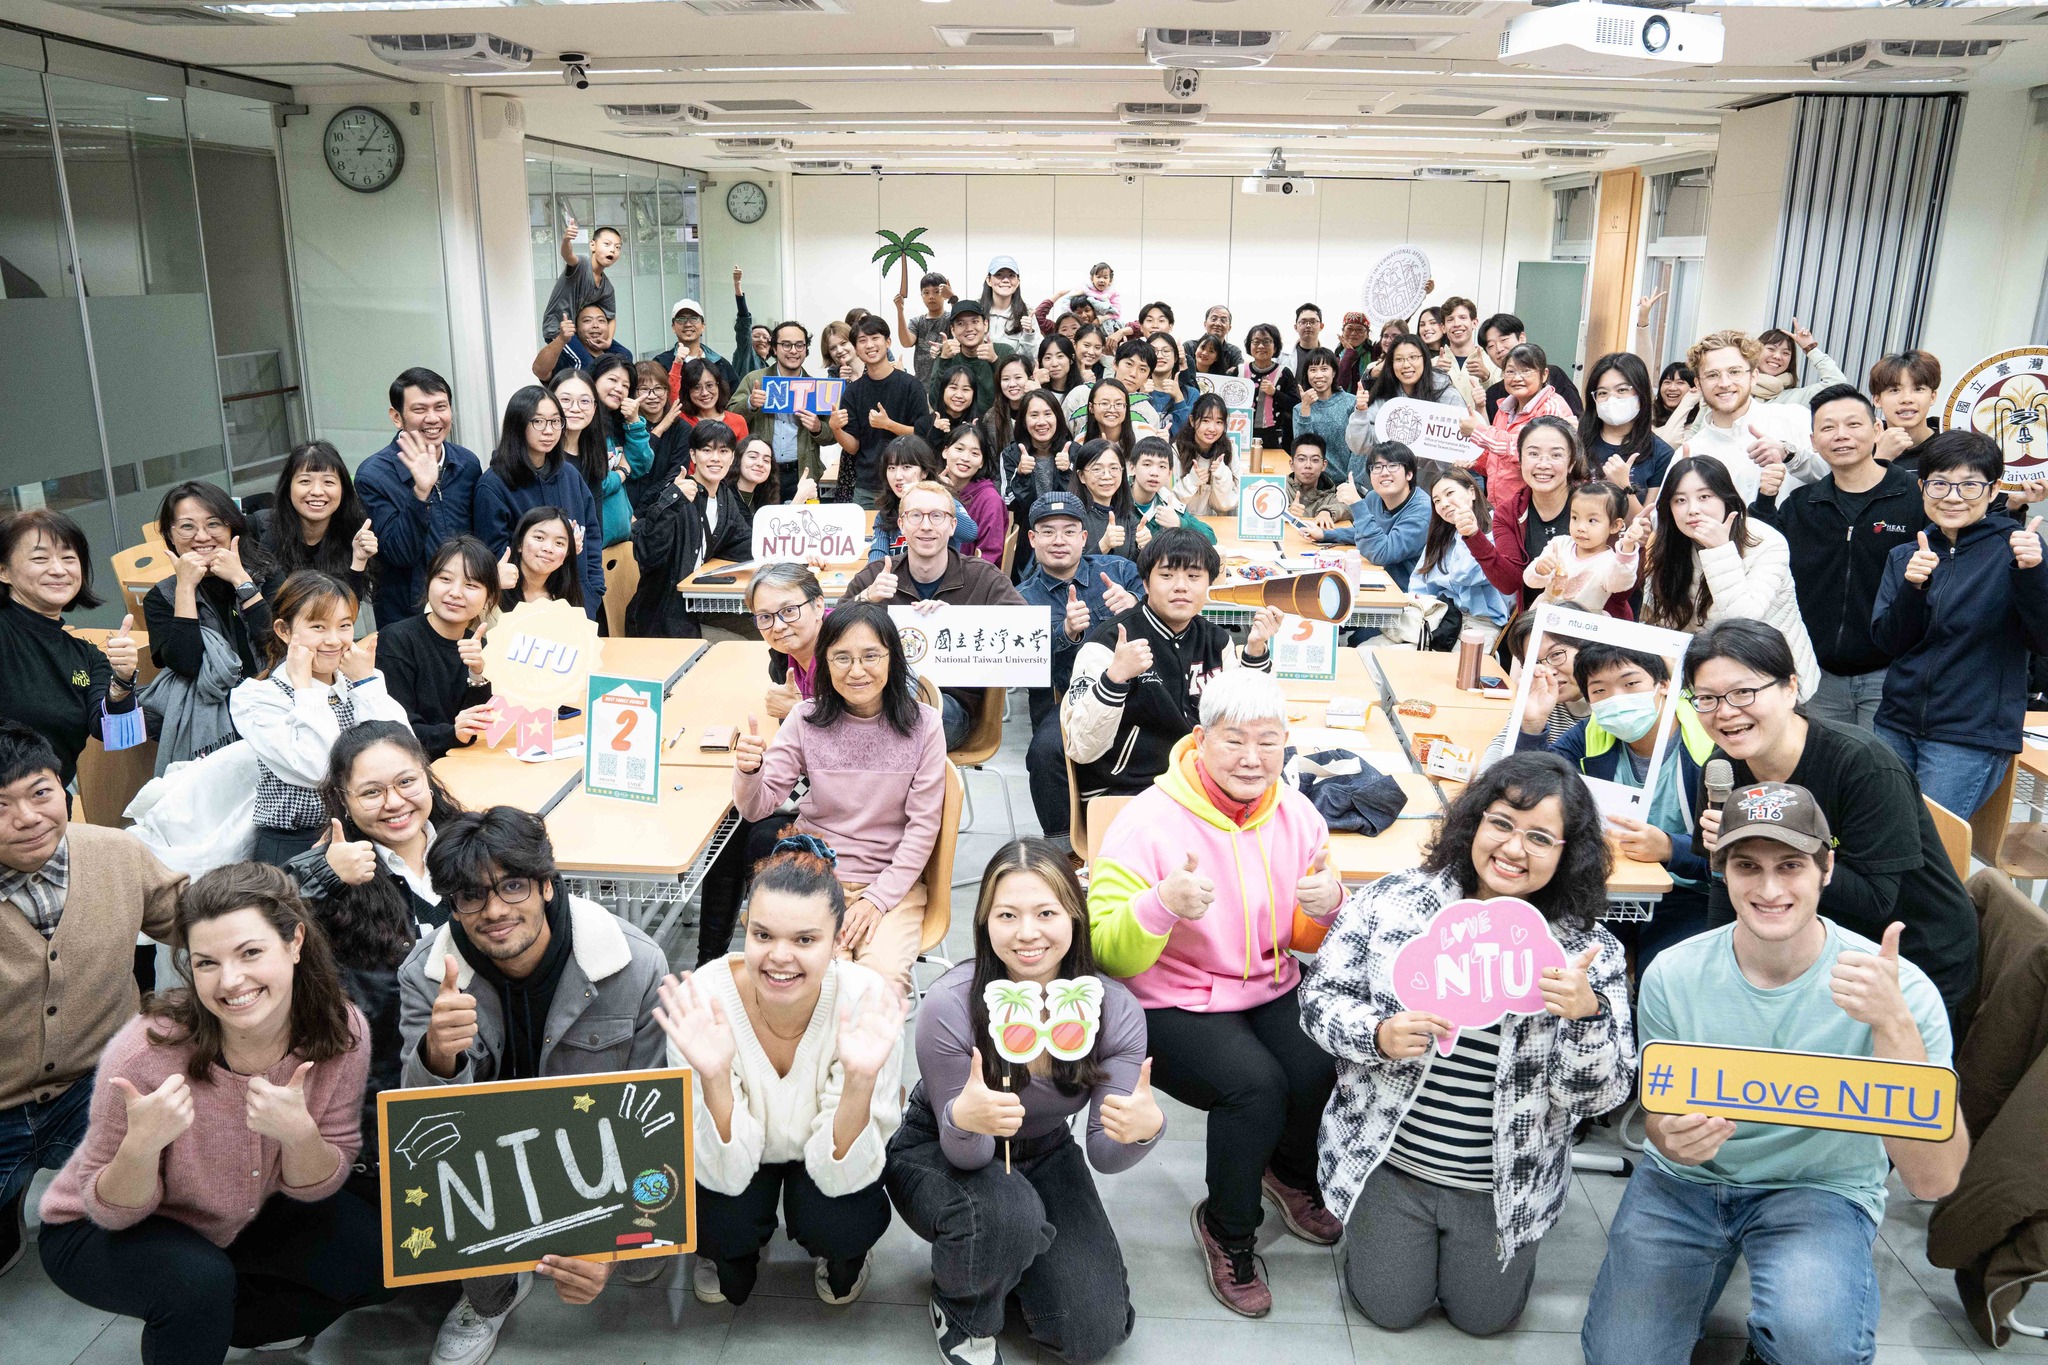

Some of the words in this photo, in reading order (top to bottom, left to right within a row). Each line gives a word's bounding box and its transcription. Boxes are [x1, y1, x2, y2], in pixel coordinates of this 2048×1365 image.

[342, 120, 351, 130] 11
[355, 115, 366, 125] 12
[333, 132, 344, 142] 10
[382, 129, 390, 139] 2
[331, 147, 340, 157] 9
[387, 144, 395, 153] 3
[337, 161, 346, 171] 8
[349, 171, 356, 181] 7
[363, 175, 372, 185] 6
[377, 170, 385, 180] 5
[763, 379, 844, 412] NTU
[1229, 419, 1247, 431] 12
[1425, 422, 1472, 443] NTU-O
[1255, 492, 1269, 514] 6
[762, 535, 856, 557] NTU-OIA
[1567, 619, 1599, 632] ntu.oia
[506, 631, 579, 674] NTU
[934, 655, 971, 664] National
[973, 655, 1004, 664] Taiwan
[1005, 655, 1049, 665] University
[610, 709, 639, 752] 2
[1434, 942, 1534, 1003] NTU
[1690, 1067, 1697, 1099] I
[1716, 1069, 1820, 1110] Love
[1838, 1080, 1941, 1122] NTU
[436, 1117, 628, 1242] NTU
